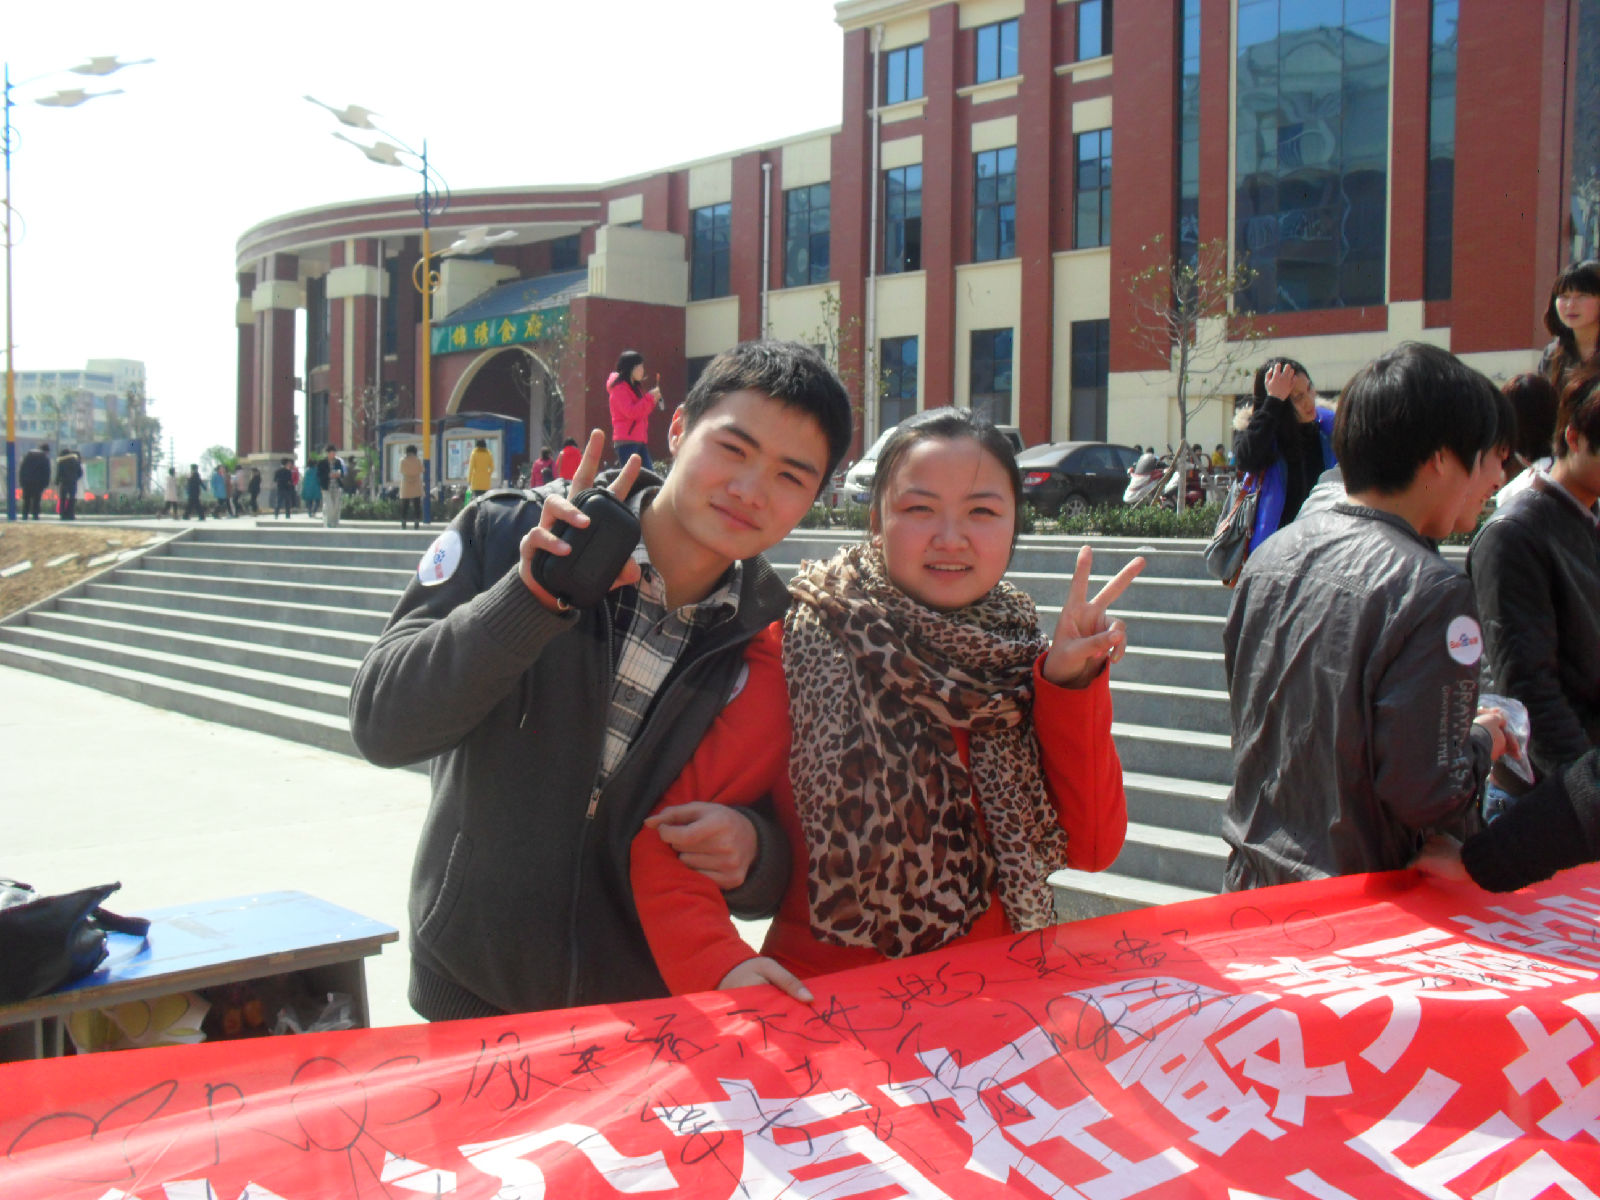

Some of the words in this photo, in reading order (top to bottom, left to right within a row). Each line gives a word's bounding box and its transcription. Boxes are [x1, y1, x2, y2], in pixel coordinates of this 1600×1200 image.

[95, 886, 1600, 1200] 有在最美丽的
